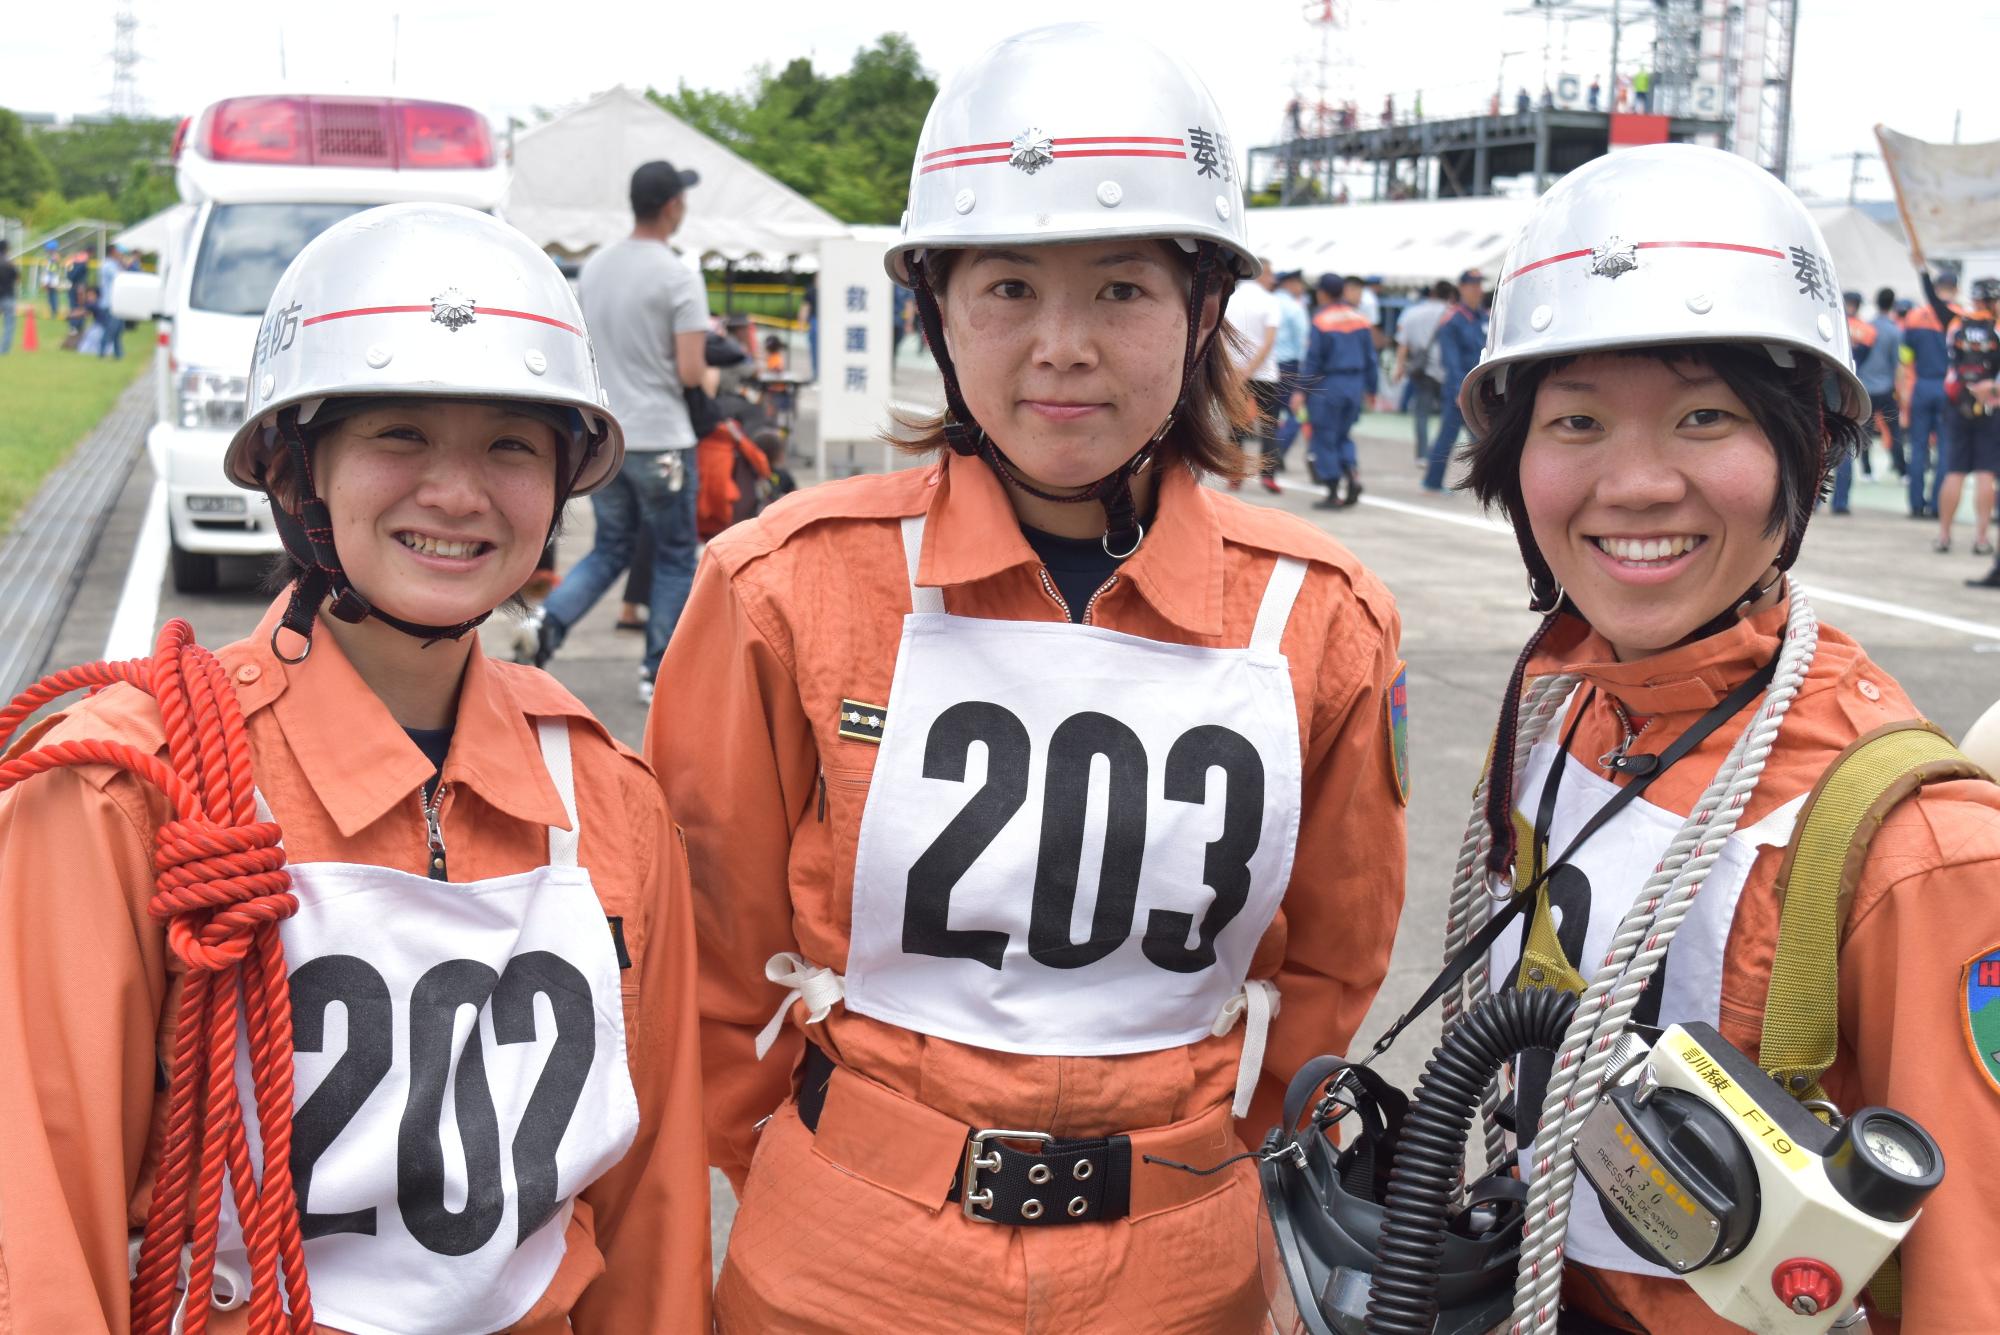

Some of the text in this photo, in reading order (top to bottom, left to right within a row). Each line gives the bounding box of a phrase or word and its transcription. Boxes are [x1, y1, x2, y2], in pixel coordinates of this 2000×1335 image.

[1557, 77, 1579, 101] C
[902, 700, 1264, 974] 203
[290, 950, 596, 1257] 202
[1597, 1147, 1639, 1201] PRESSURE
